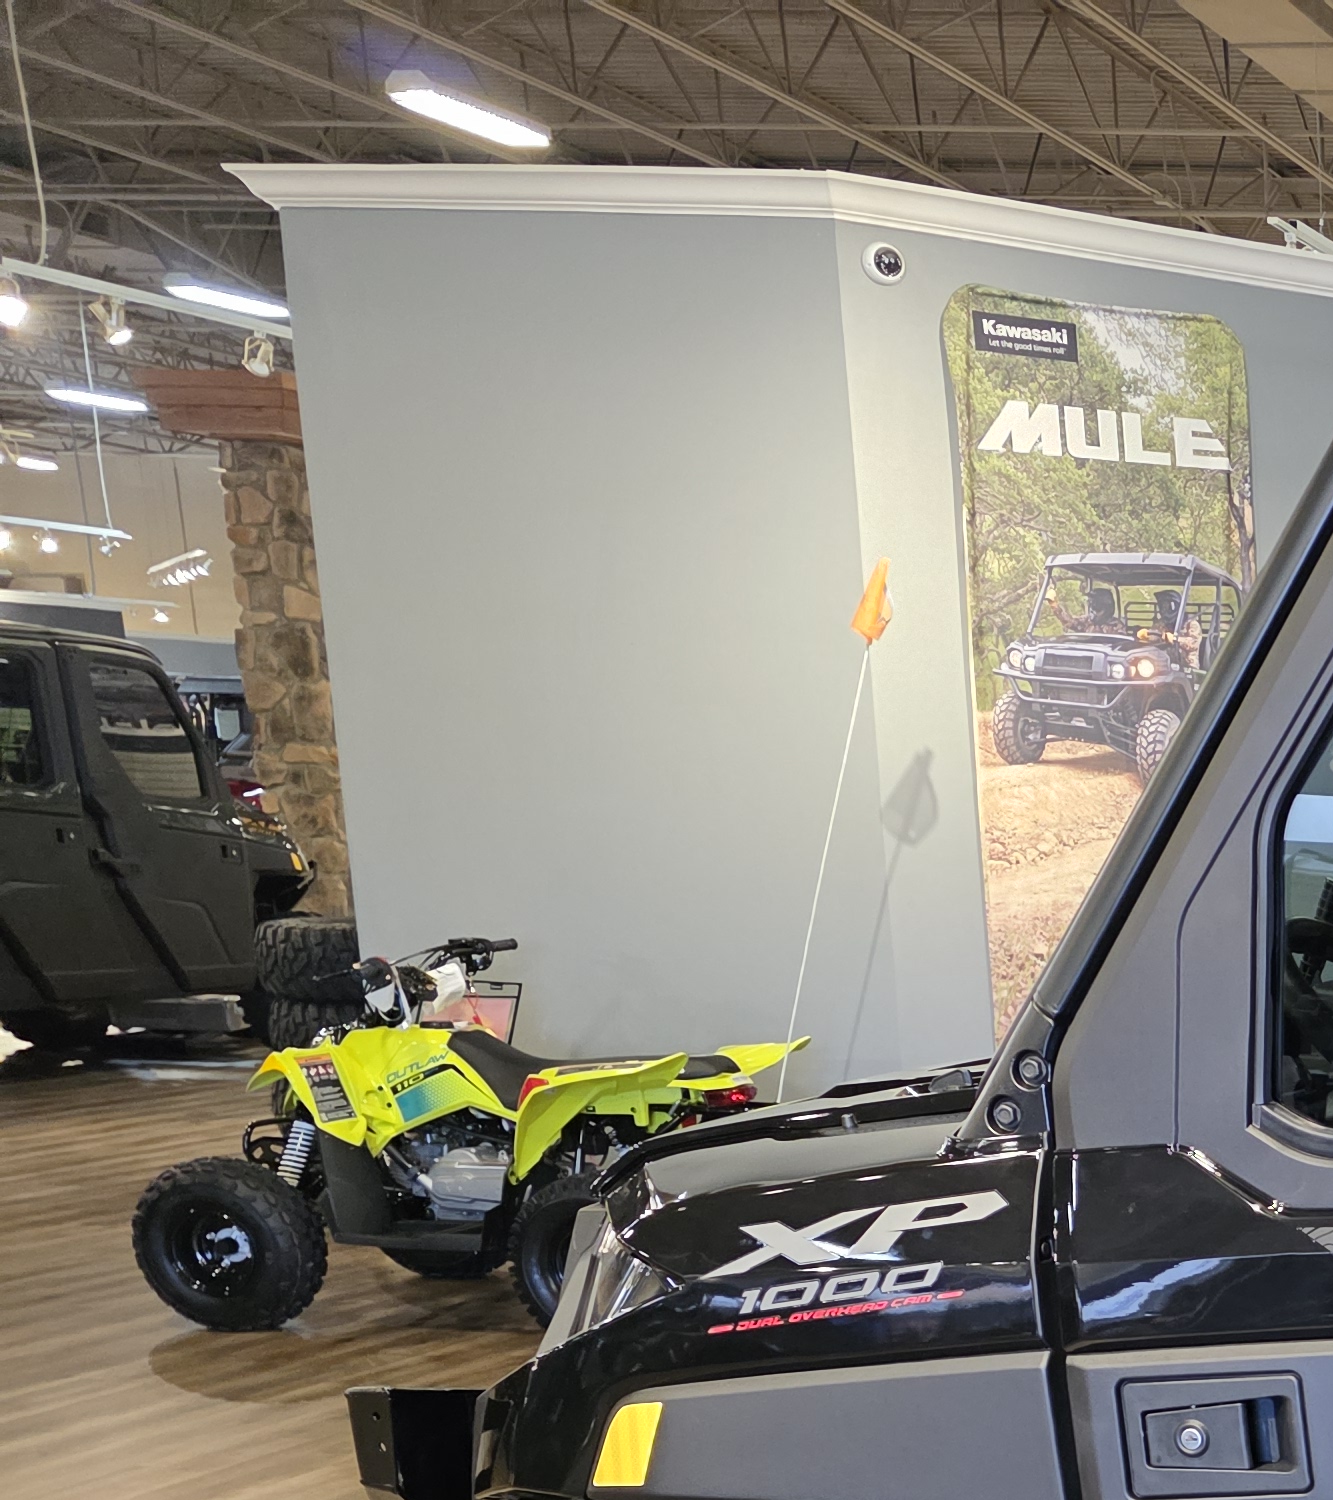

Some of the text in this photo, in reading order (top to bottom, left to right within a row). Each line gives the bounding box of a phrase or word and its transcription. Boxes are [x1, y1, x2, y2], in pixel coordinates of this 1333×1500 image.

[982, 318, 1068, 345] Kawasaki
[1001, 340, 1012, 349] the
[1014, 341, 1032, 352] good
[1033, 344, 1051, 353] times
[977, 400, 1232, 471] MULE
[386, 1051, 450, 1084] OUTLAW
[395, 1073, 424, 1092] 110
[699, 1189, 1010, 1280] XP
[738, 1260, 943, 1315] 1000
[736, 1294, 932, 1332] DUAL OVERHEAD CAM
